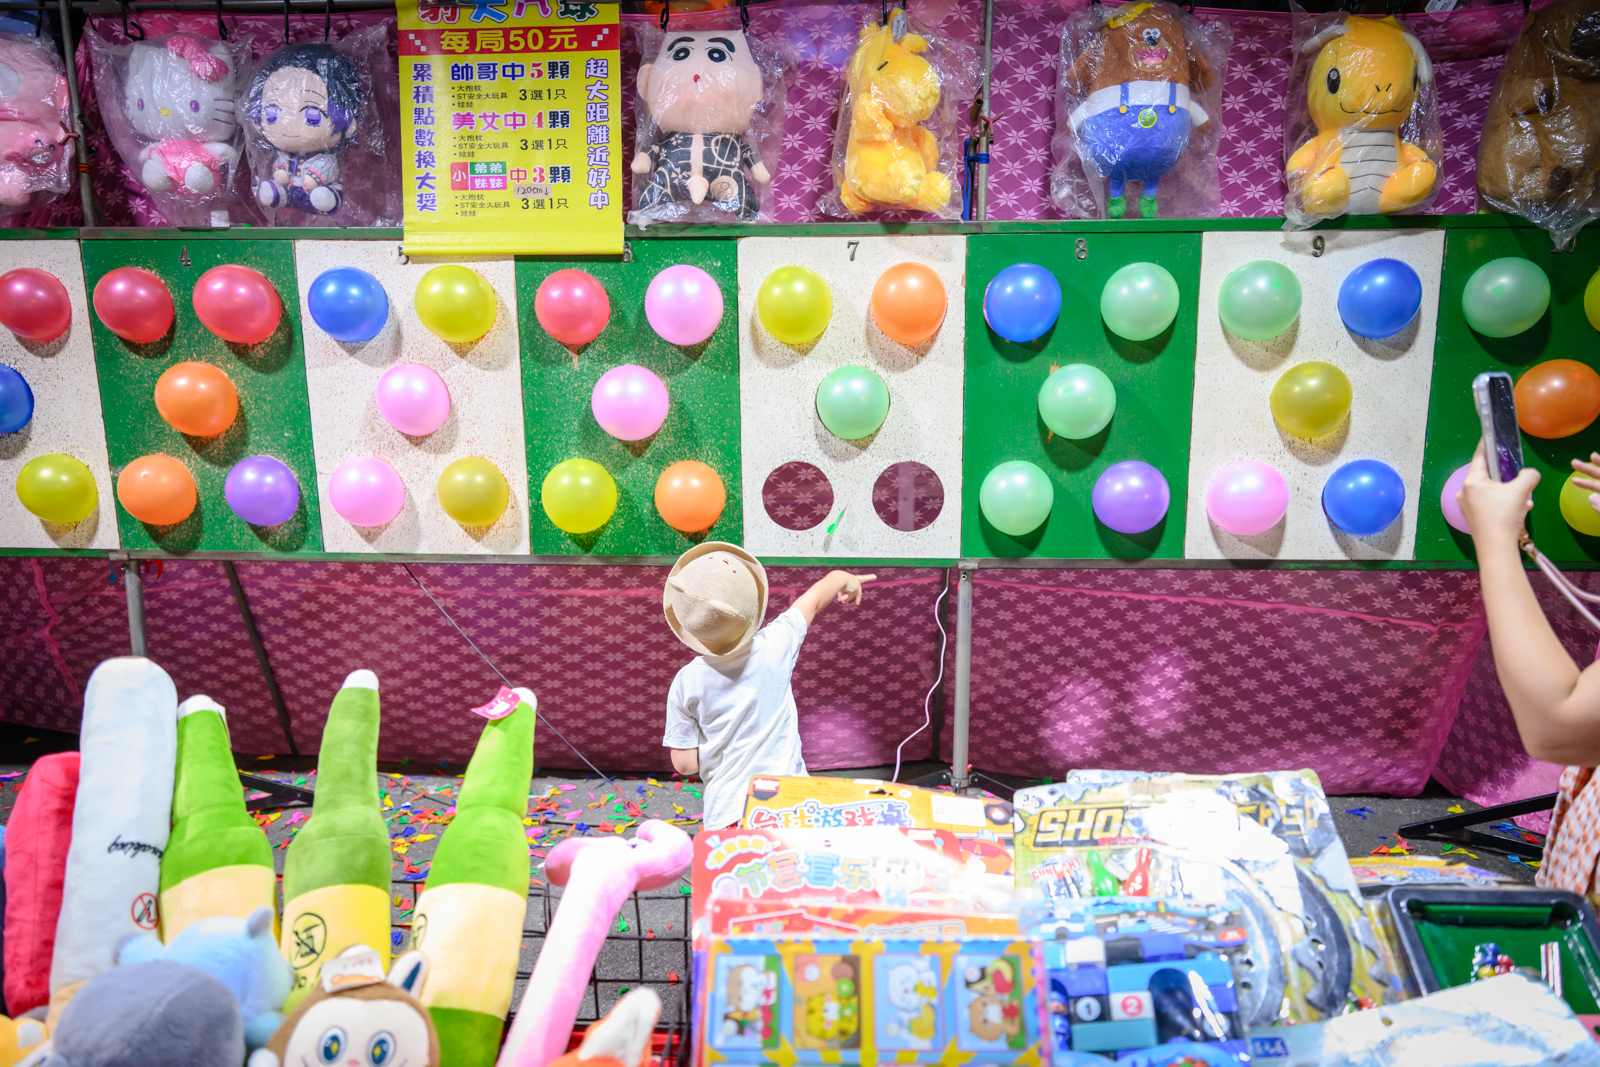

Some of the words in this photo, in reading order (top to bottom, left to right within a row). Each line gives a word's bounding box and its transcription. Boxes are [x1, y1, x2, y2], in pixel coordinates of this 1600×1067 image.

[440, 28, 578, 53] 每局50元
[450, 60, 570, 82] 帥哥中5顆
[457, 92, 508, 100] ST安全大玩具
[519, 88, 567, 101] 3選1只
[451, 109, 570, 132] 美女中4顆
[411, 62, 438, 212] 累積點數換大獎
[458, 134, 483, 142] 大抱枕
[585, 57, 611, 210] 超大距離近好中
[520, 138, 568, 151] 3選1只
[474, 162, 503, 174] 弟弟
[509, 165, 571, 184] 中3顆
[453, 170, 467, 182] 小
[474, 177, 504, 189] 妹妹
[460, 193, 485, 201] 大抱枕
[460, 201, 510, 209] ST安全大玩具
[521, 198, 569, 210] 3選1只
[846, 240, 861, 262] 7
[1075, 237, 1089, 260] 8
[1312, 234, 1325, 258] 9
[179, 245, 191, 267] 4
[1083, 1003, 1092, 1016] 1
[1126, 999, 1139, 1013] 2
